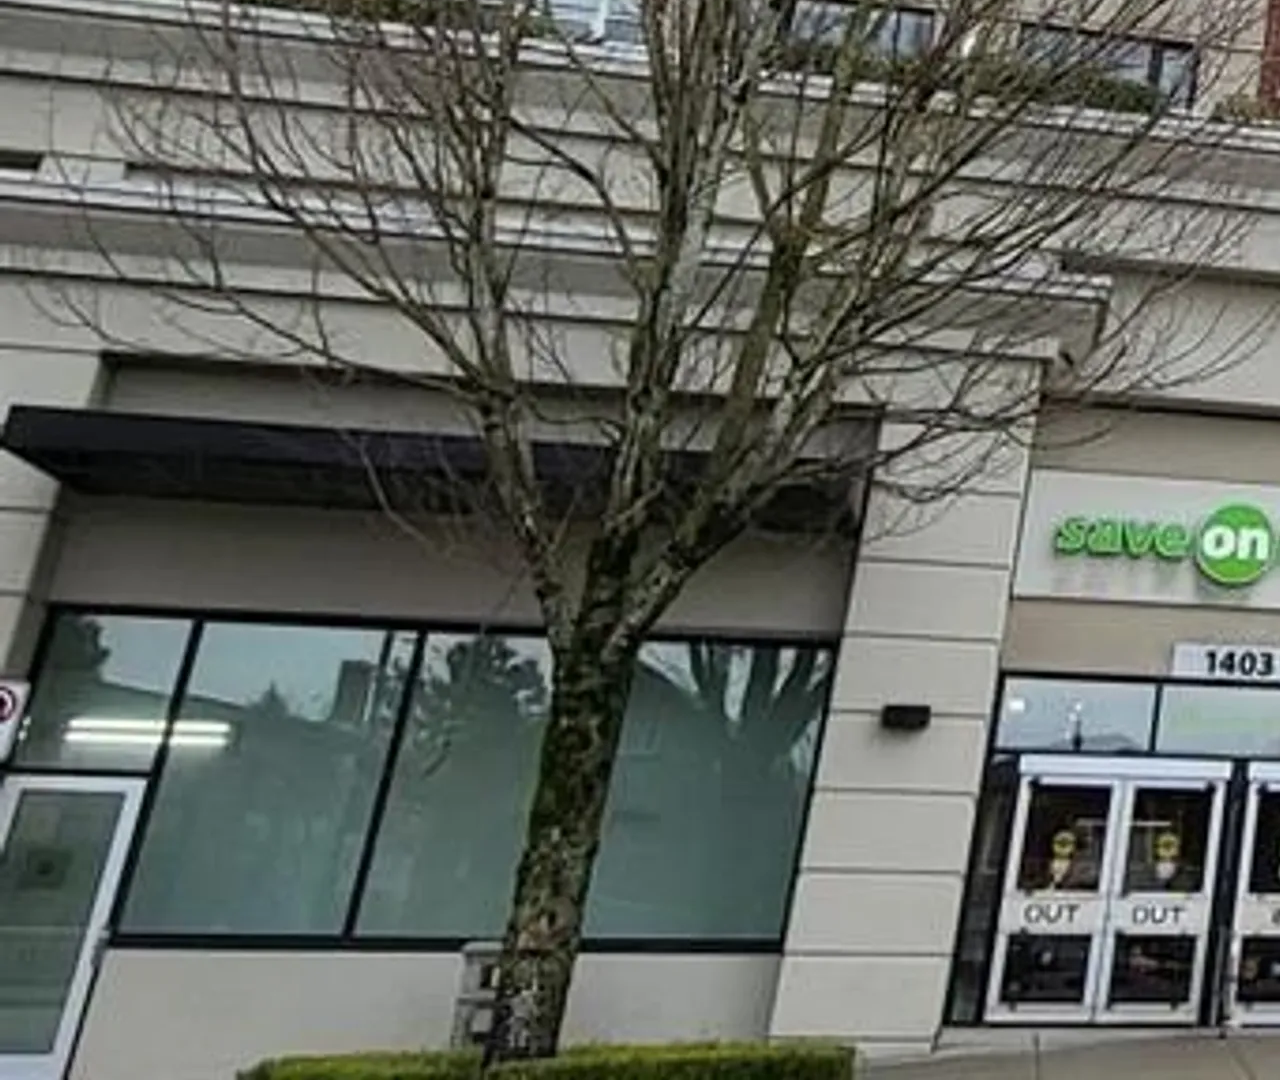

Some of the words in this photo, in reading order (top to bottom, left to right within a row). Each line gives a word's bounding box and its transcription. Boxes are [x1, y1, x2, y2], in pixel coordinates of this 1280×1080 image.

[1056, 515, 1192, 560] save
[1202, 523, 1269, 560] on
[1205, 650, 1275, 677] 1403
[1023, 903, 1080, 924] OUT
[1132, 905, 1187, 925] OUT
